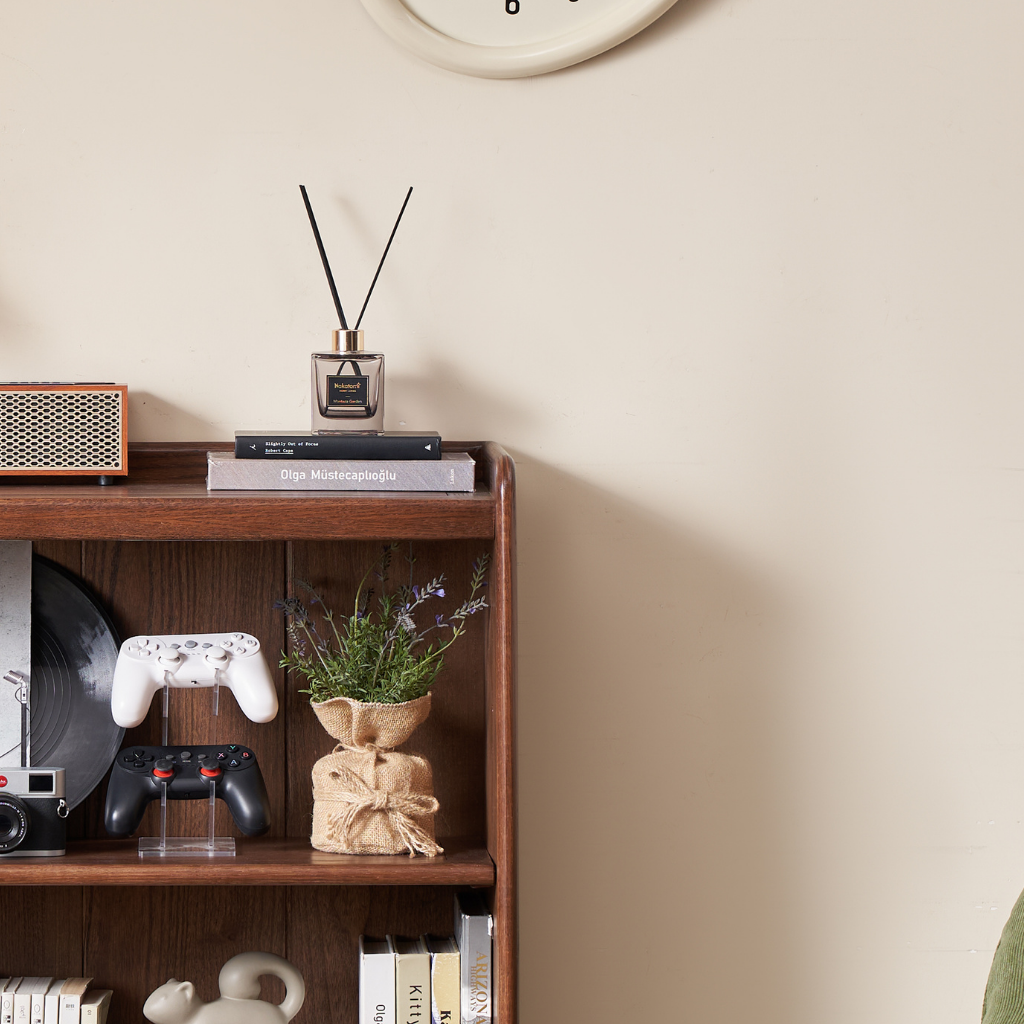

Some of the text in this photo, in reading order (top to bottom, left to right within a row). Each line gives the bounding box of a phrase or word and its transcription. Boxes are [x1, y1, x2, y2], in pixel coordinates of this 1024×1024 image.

[280, 469, 396, 482] Olga Müstecaplıoğlu
[477, 951, 488, 1024] ARIZONA
